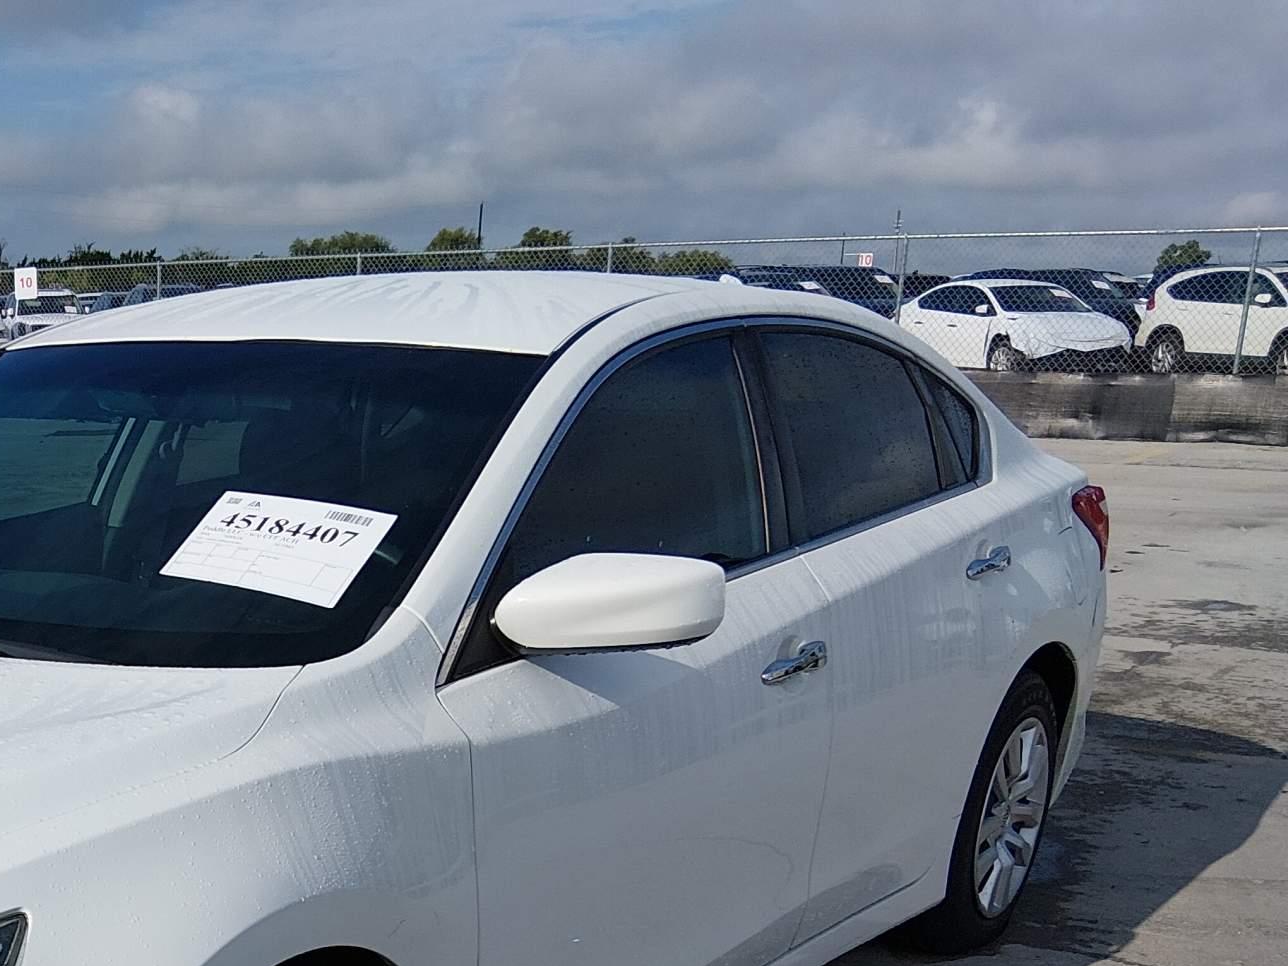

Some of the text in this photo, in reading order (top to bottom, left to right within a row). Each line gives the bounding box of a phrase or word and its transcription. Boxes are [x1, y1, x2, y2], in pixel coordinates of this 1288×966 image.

[859, 254, 872, 266] 10
[19, 276, 33, 289] 10
[220, 511, 360, 547] 45184407
